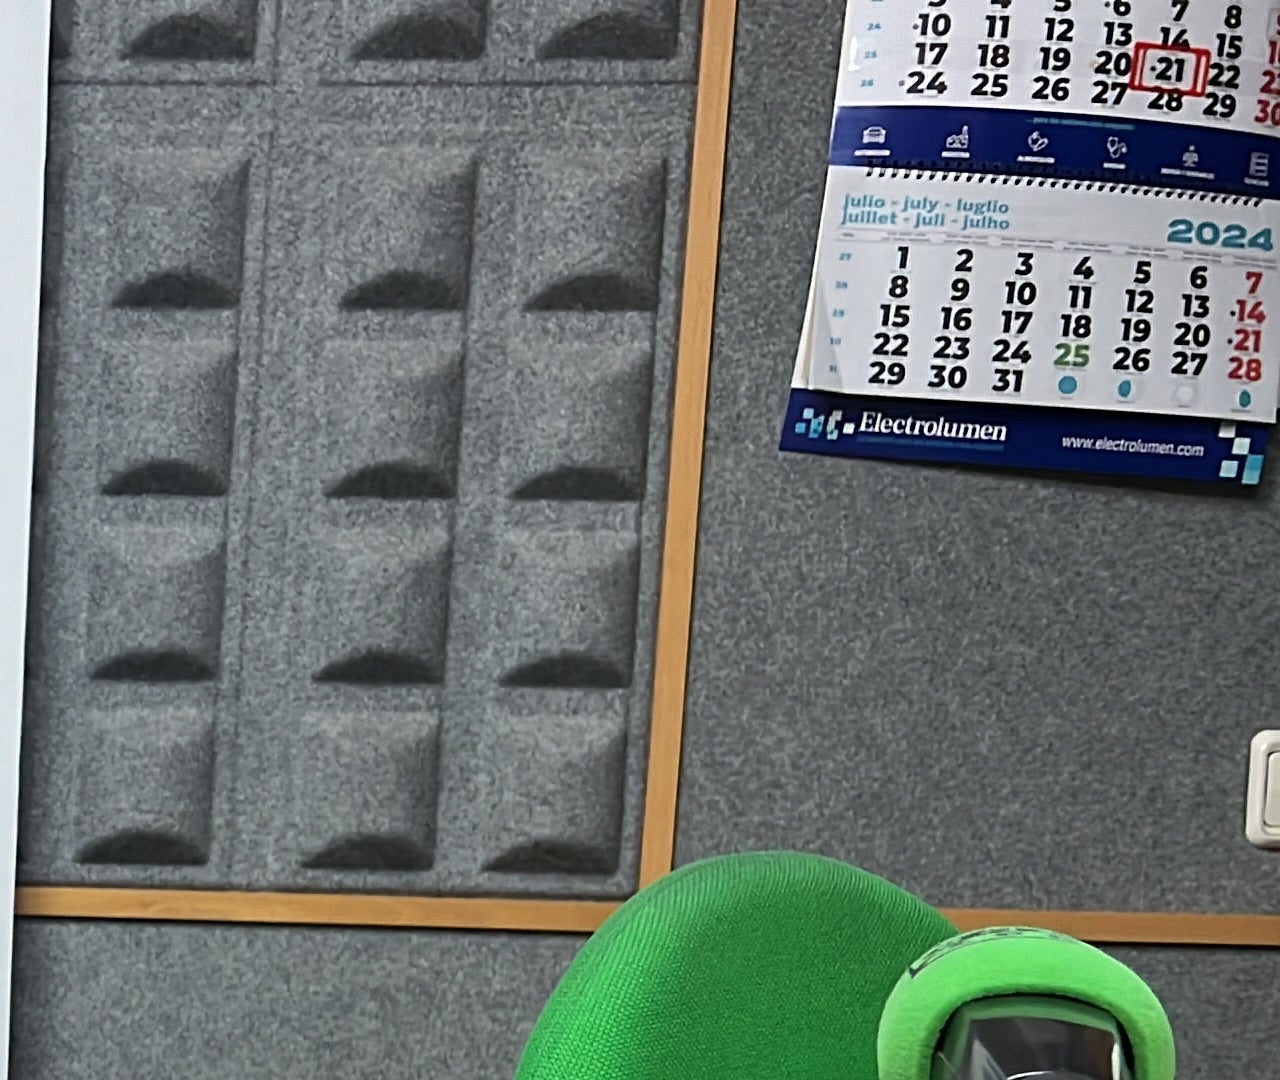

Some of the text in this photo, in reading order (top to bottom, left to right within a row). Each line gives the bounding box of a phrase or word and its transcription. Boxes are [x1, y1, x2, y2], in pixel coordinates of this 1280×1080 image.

[1171, 0, 1189, 22] 7
[1224, 5, 1242, 29] 8
[918, 13, 951, 37] 10
[985, 15, 1010, 38] 11
[1044, 17, 1074, 42] 12
[1104, 21, 1133, 46] 13
[1160, 27, 1190, 49] 14
[1216, 33, 1243, 60] 15
[915, 43, 949, 65] 17
[978, 44, 1010, 68] 18
[1040, 47, 1071, 72] 19
[1094, 50, 1132, 76] 20
[1155, 57, 1185, 82] 21
[1208, 62, 1241, 90] 22
[906, 71, 948, 94] 24
[971, 73, 1009, 97] 25
[1031, 76, 1071, 101] 26
[1091, 80, 1129, 105] 27
[1147, 86, 1183, 112] 28
[1203, 92, 1237, 118] 29
[841, 210, 898, 226] juillet
[914, 213, 945, 229] juli
[961, 214, 1010, 231] julho
[843, 194, 886, 211] julio
[903, 196, 939, 213] july
[957, 198, 1010, 216] luglio
[1167, 218, 1274, 251] 2024
[897, 246, 909, 269] 1
[955, 248, 974, 272] 2
[1015, 252, 1034, 276] 3
[1073, 256, 1094, 280] 4
[1133, 260, 1152, 284] 5
[1190, 266, 1208, 289] 6
[1245, 271, 1263, 295] 7
[889, 275, 909, 298] 8
[951, 278, 970, 301] 9
[1005, 281, 1037, 305] 10
[1069, 285, 1092, 309] 11
[1125, 289, 1154, 314] 12
[1182, 294, 1210, 318] 13
[1236, 299, 1266, 324] 14
[880, 304, 1262, 353] 15 16 17 18 19 20 21
[868, 362, 1023, 392] 29 30 31
[873, 333, 1262, 382] 22 23 24 25 26 27 28
[859, 411, 1007, 441] Electrolumen
[1061, 435, 1205, 457] www.electrolumen.com
